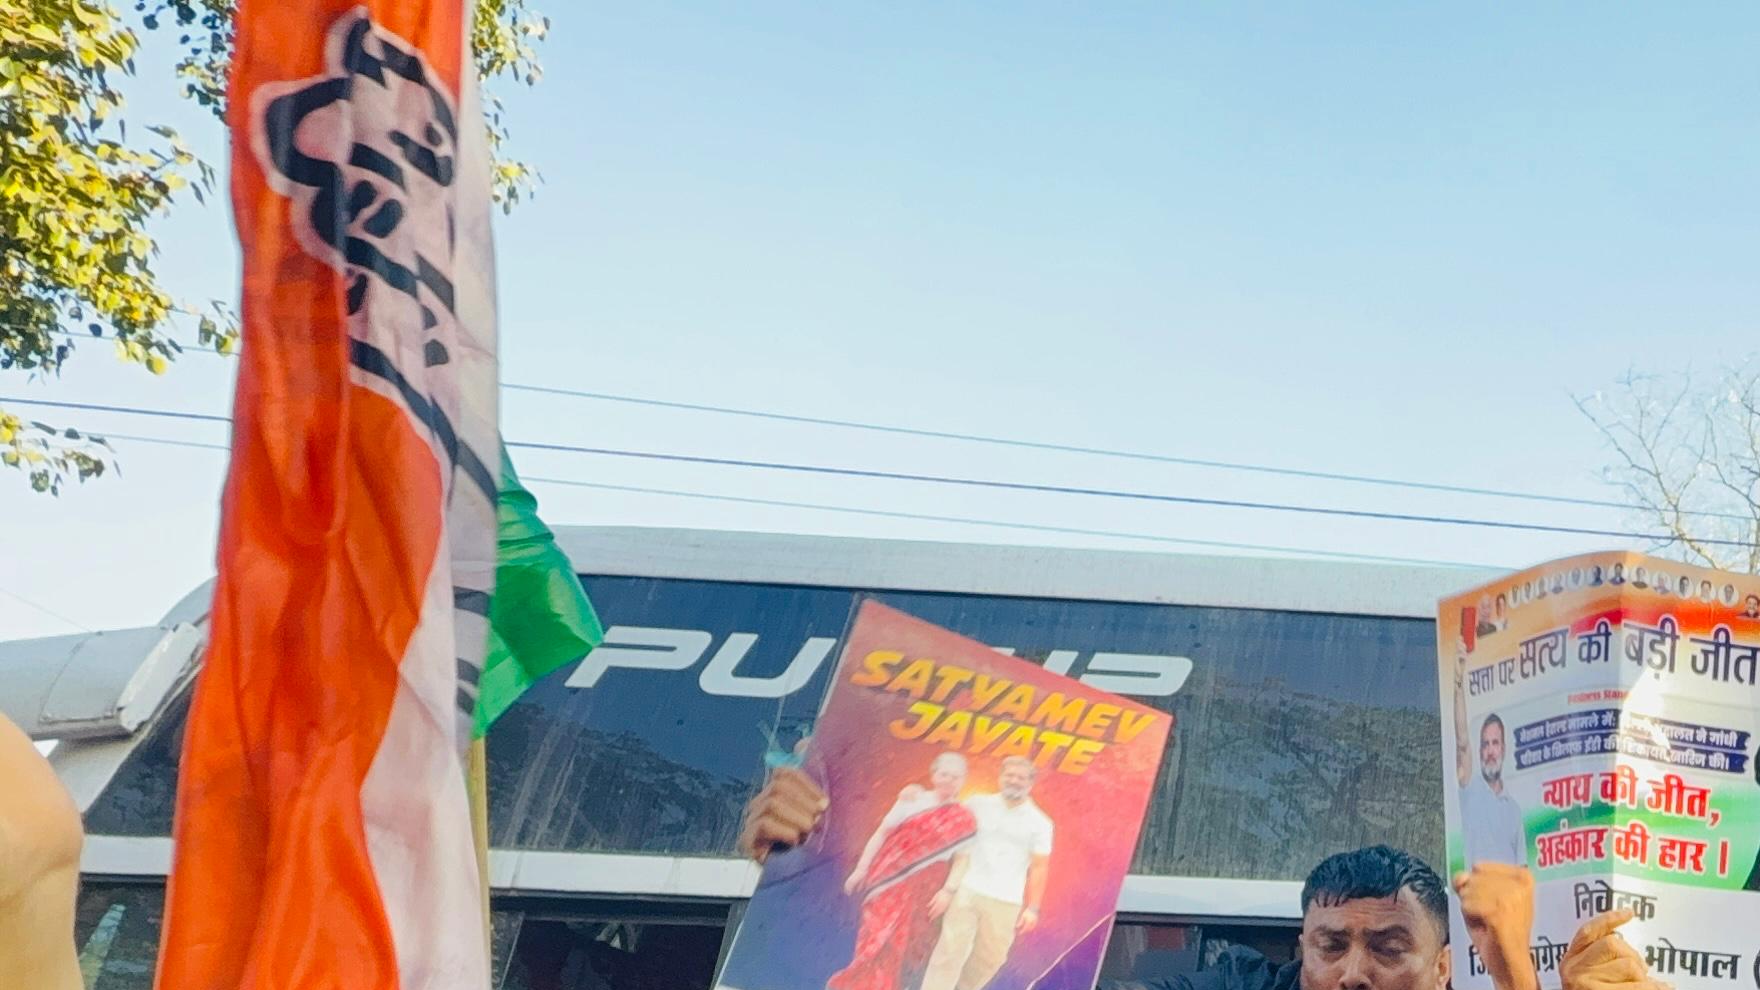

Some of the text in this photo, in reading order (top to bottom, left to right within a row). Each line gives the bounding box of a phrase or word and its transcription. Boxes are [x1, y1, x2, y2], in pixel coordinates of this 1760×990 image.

[565, 625, 1192, 699] PUP
[1469, 665, 1494, 696] सत्ता
[1499, 657, 1515, 687] पर
[1519, 628, 1569, 679] सत्य
[1577, 620, 1612, 664] की
[1623, 616, 1680, 680] बड़ी
[850, 650, 1158, 744] SATYAMEV
[1568, 712, 1599, 731] मामले
[889, 700, 1105, 776] JAYATE
[1542, 765, 1720, 826] न्याय की जीत,
[1536, 820, 1608, 868] अहंकार
[1613, 822, 1650, 865] की
[1658, 836, 1708, 872] हार
[1645, 937, 1743, 981] भोपाल
